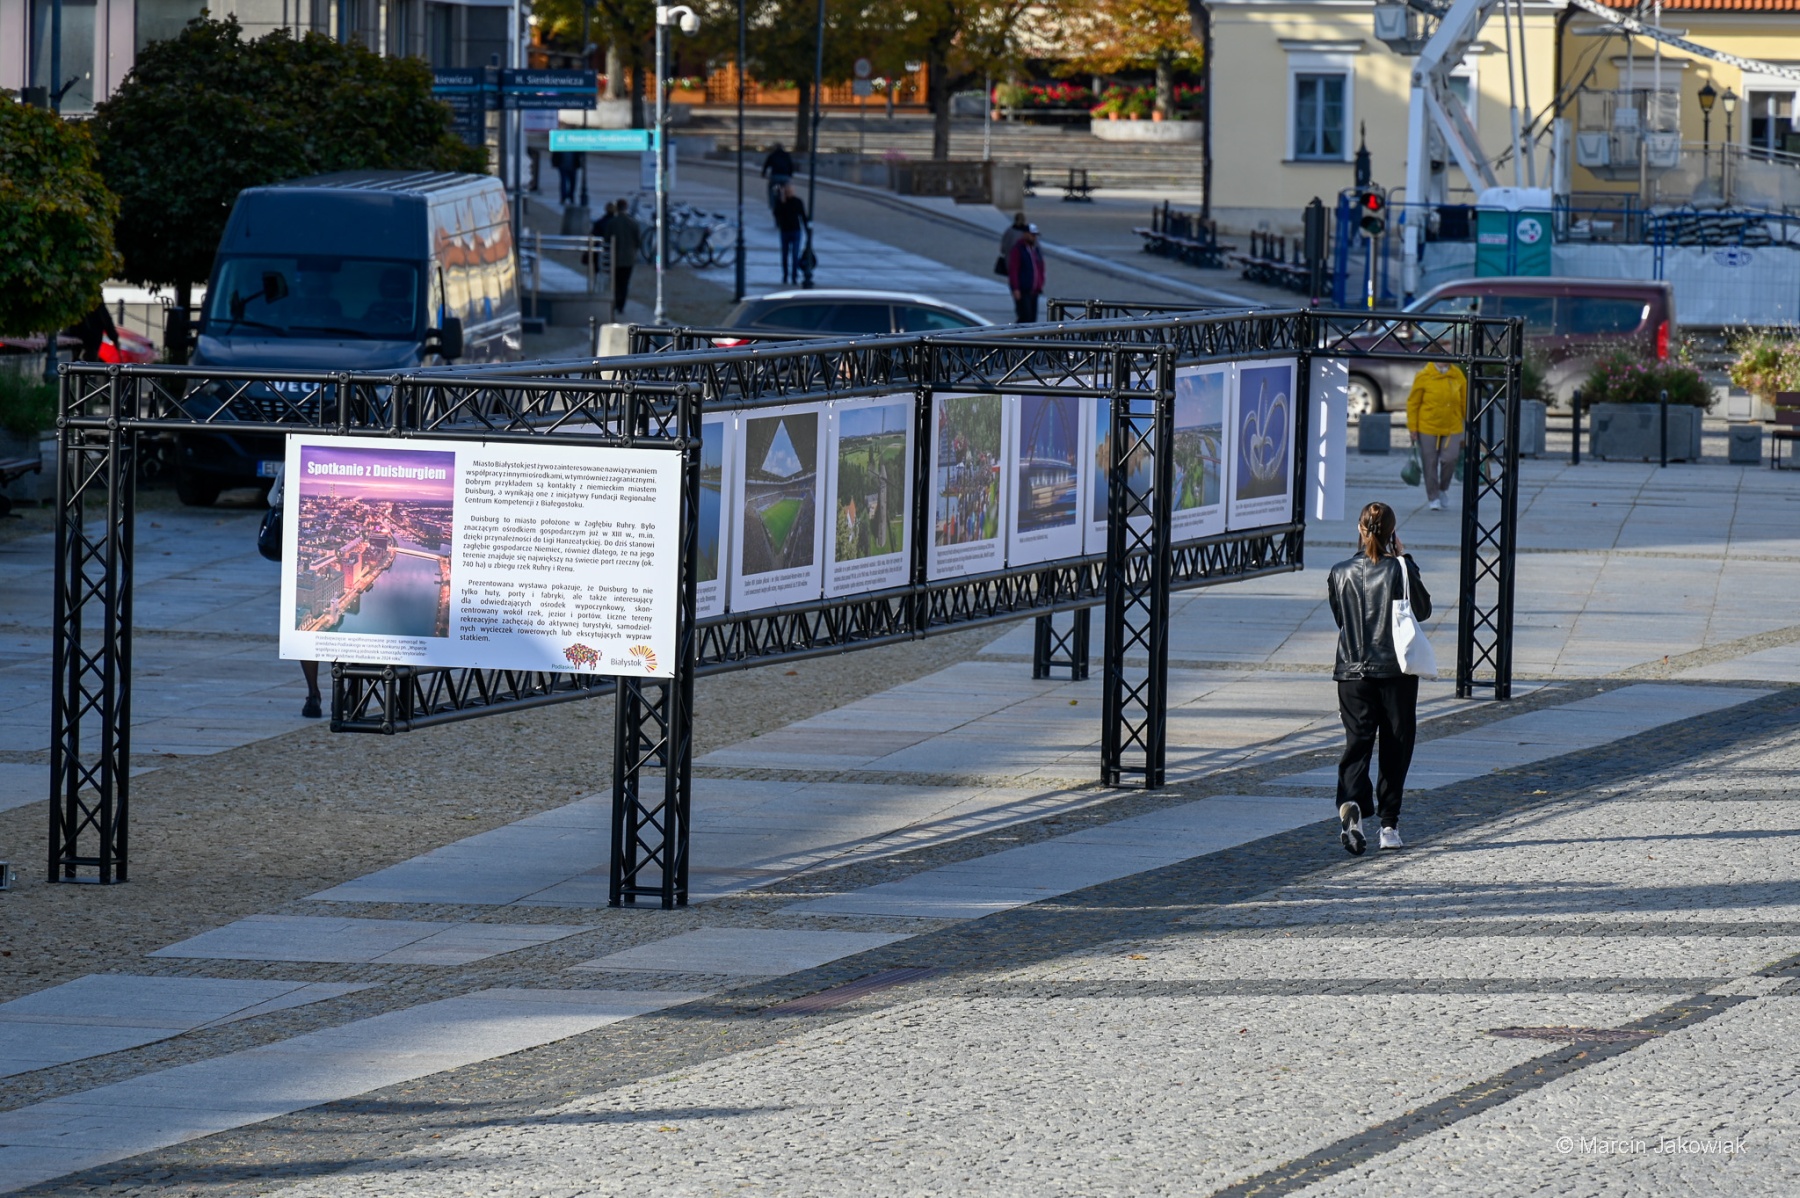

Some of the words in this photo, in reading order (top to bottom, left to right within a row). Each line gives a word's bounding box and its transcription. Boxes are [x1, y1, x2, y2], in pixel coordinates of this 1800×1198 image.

[527, 75, 584, 85] Sienkiewicza
[307, 461, 363, 476] Spotkanie
[373, 464, 446, 480] Duisburgiem
[465, 478, 491, 486] Dobrym
[547, 482, 576, 490] kontakty
[465, 487, 496, 496] Duisburg,
[591, 493, 618, 501] Fundacji
[620, 494, 656, 502] Regionalne
[494, 498, 534, 506] Kompetencji
[470, 515, 500, 524] Duisburg
[584, 520, 612, 528] Zagłębiu
[616, 521, 636, 530] Ruhry.
[640, 522, 656, 530] Było
[539, 528, 586, 536] gospodarczym
[543, 537, 555, 545] Ligi
[592, 548, 618, 557] dlatego,
[487, 553, 515, 561] znajduje
[527, 555, 564, 563] największy
[475, 561, 486, 569] ha)
[494, 562, 516, 571] zbiegu
[532, 564, 551, 572] Ruhry
[468, 579, 514, 587] Prezentowana
[598, 585, 628, 594] Duisburg
[461, 588, 478, 596] tylko
[484, 589, 501, 597] huty,
[541, 592, 565, 600] fabryki,
[613, 596, 653, 604] interesujący
[480, 598, 532, 607] odwiedzających
[460, 607, 499, 615] centrowany
[460, 615, 498, 624] rekreacyjne
[502, 617, 534, 626] zachęcają
[548, 620, 579, 628] aktywnej
[460, 624, 476, 633] nych
[576, 630, 622, 639] ekscytujących
[611, 658, 642, 667] Białystok
